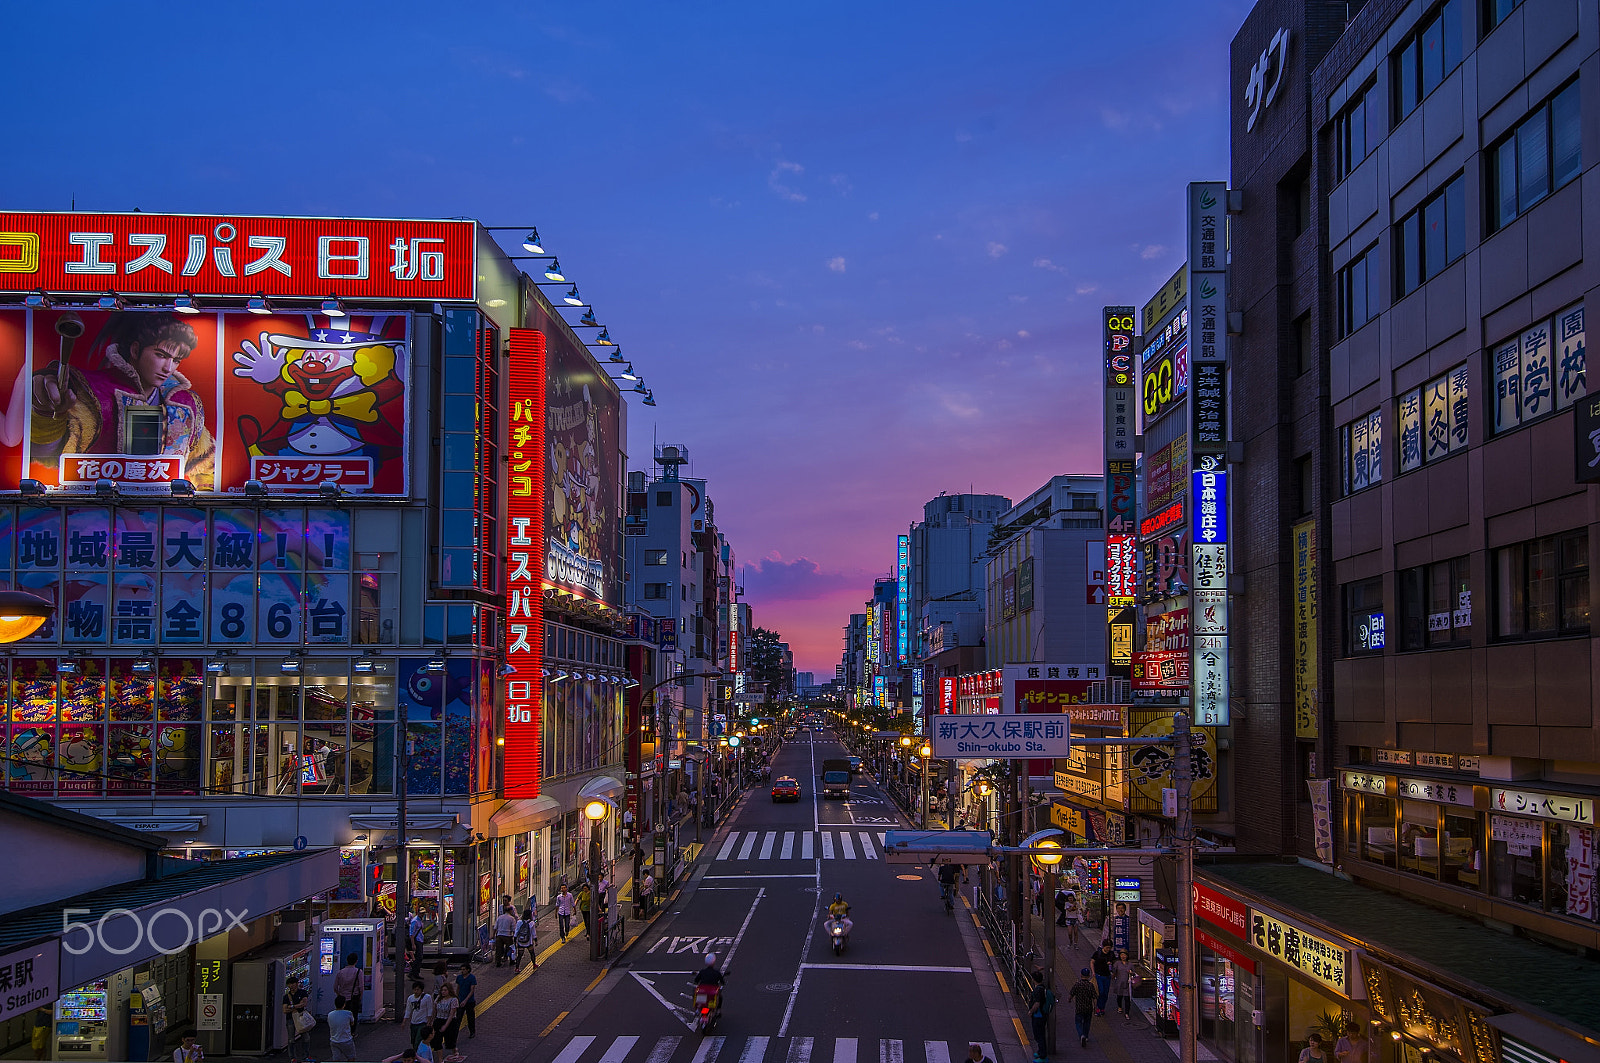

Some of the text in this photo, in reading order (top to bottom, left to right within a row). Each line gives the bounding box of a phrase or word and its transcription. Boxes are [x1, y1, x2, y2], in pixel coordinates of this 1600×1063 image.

[65, 222, 292, 284] エスパス
[318, 236, 444, 280] 日拓
[1202, 215, 1215, 268] 交通建設
[1109, 317, 1133, 331] QQ
[1202, 305, 1215, 358] 交通建設
[1145, 359, 1173, 415] QQ
[514, 399, 533, 496] パチンコ
[77, 460, 171, 480] 花の慶次
[259, 462, 366, 482] ジャグラー
[1201, 473, 1217, 543] 日本海庄や
[1109, 514, 1134, 532] 4F
[548, 537, 603, 598] JUGGLER
[1110, 543, 1121, 596] コミックカフェ
[1195, 554, 1213, 587] 住吉
[1216, 546, 1225, 579] とんかつ
[511, 518, 533, 654] エスパス
[1200, 638, 1222, 648] 24h
[1028, 667, 1099, 678] 低貸専門
[939, 720, 1064, 740] 新大久保駅前
[1205, 713, 1218, 724] B1
[957, 741, 1046, 752] Shin-okubo Sta.
[1353, 773, 1385, 791] あなたの
[1516, 793, 1588, 822] シュベール
[1569, 857, 1579, 912] サービス
[1578, 829, 1592, 914] モーニング
[201, 967, 210, 994] ロッカー
[213, 961, 221, 982] コイン
[7, 987, 49, 1012] Station
